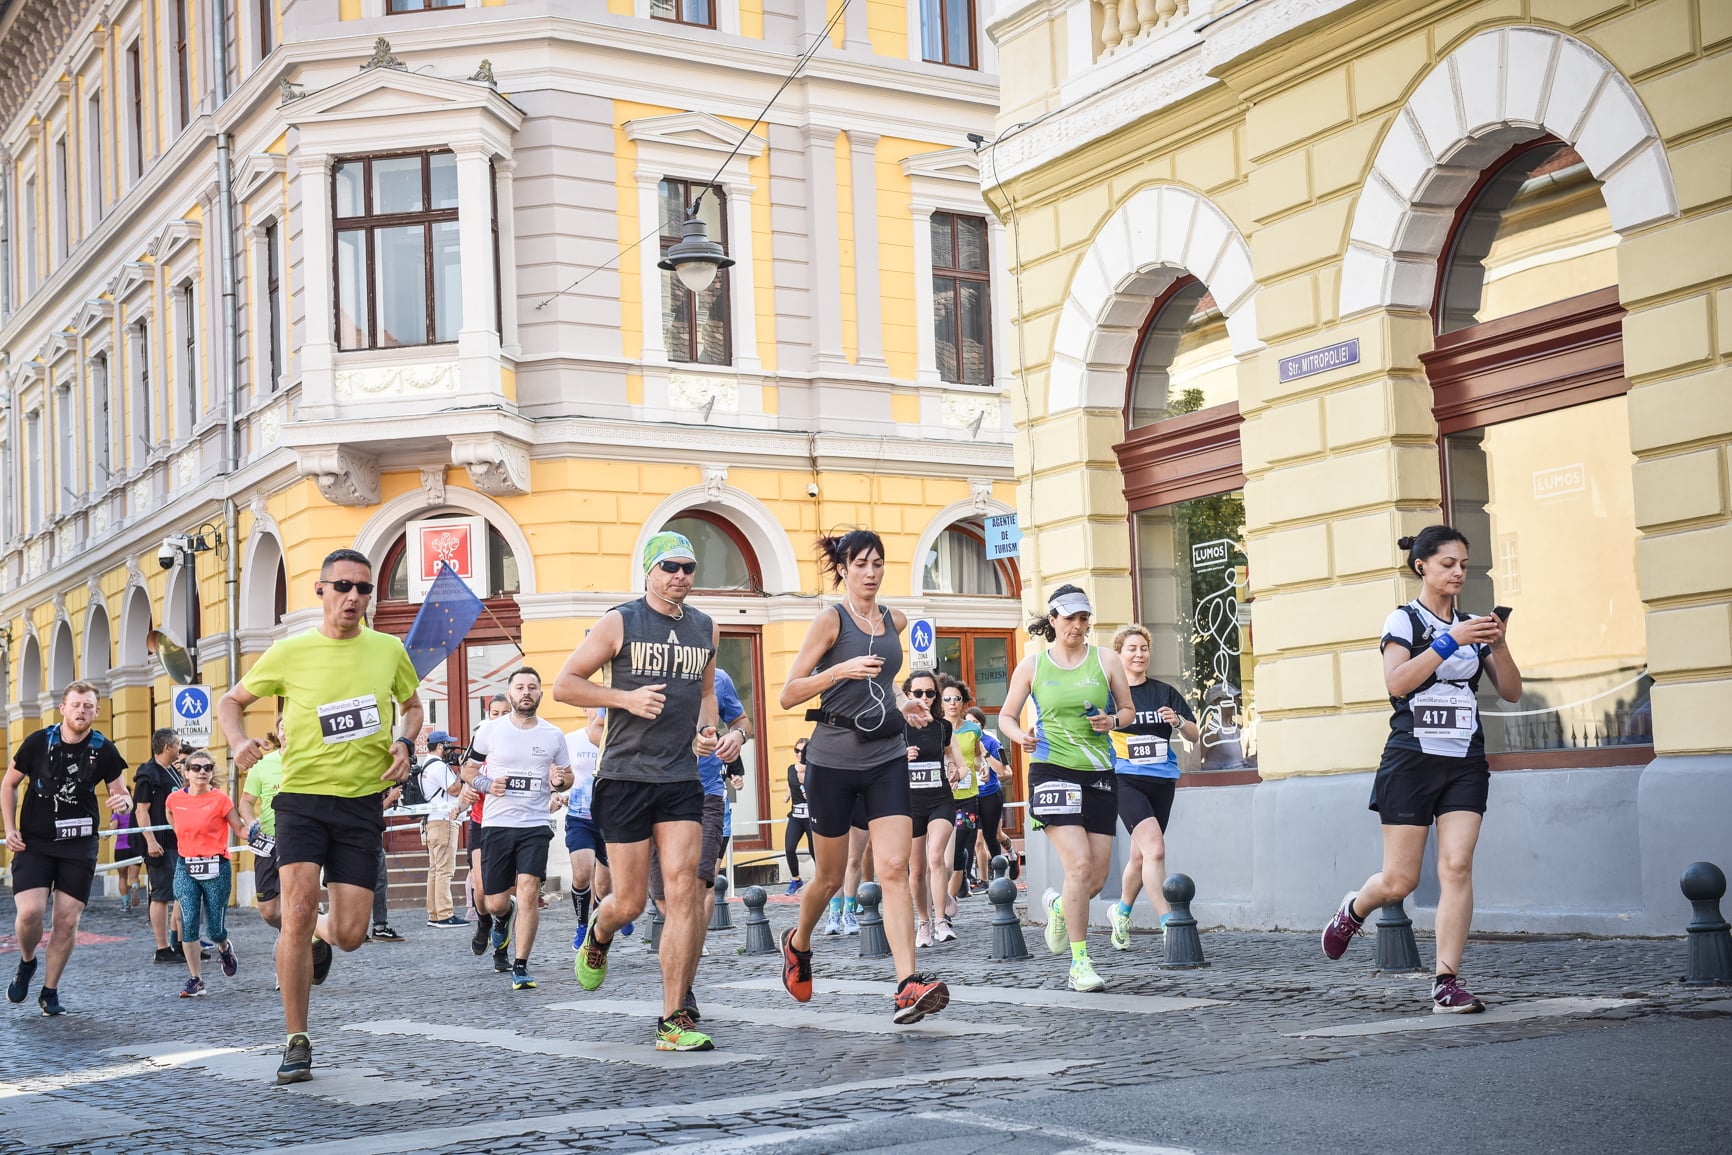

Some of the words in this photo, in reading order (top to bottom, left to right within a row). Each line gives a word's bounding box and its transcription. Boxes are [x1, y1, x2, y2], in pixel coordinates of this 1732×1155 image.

[1288, 361, 1301, 376] Str.
[1301, 346, 1349, 372] MITROPOLIEI
[1537, 471, 1580, 490] LUMOS
[1001, 530, 1009, 540] DE
[994, 542, 1018, 554] TURISM
[1195, 545, 1224, 561] LUMOS
[433, 559, 459, 574] PD
[630, 641, 670, 672] WEST
[672, 645, 711, 674] POINT
[329, 714, 354, 731] 126
[1422, 710, 1447, 724] 417
[1133, 745, 1151, 757] 288
[911, 771, 926, 780] 347
[509, 778, 526, 789] 453
[1039, 792, 1060, 804] 287
[61, 828, 77, 837] 210
[190, 864, 204, 873] 327
